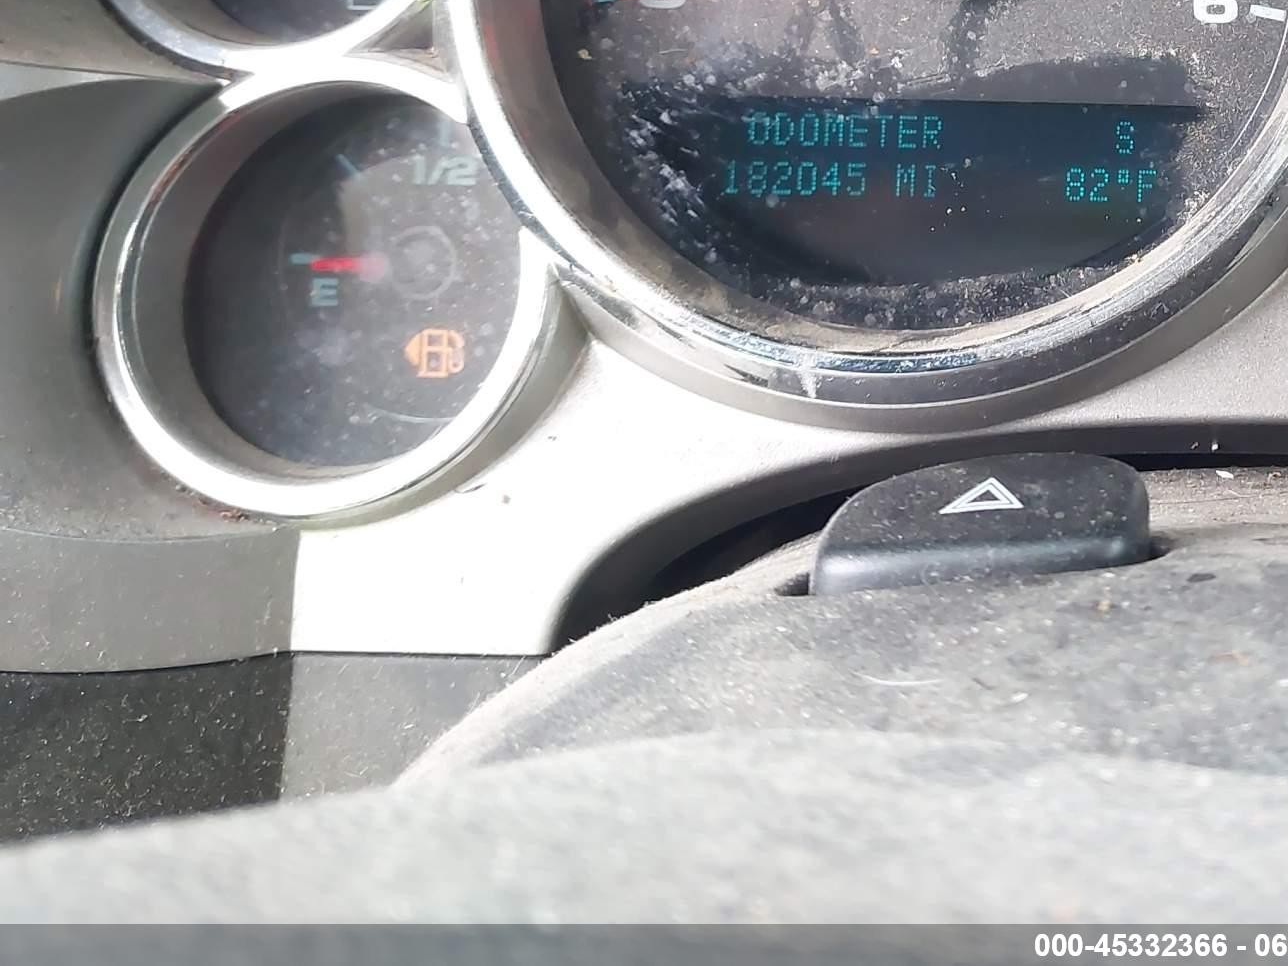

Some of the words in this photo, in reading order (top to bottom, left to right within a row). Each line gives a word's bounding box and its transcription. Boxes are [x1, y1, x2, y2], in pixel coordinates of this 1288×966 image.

[747, 111, 943, 150] ODOMETER
[409, 154, 479, 186] 1/2
[725, 159, 868, 197] 182045
[895, 163, 938, 198] MI
[310, 277, 339, 307] E
